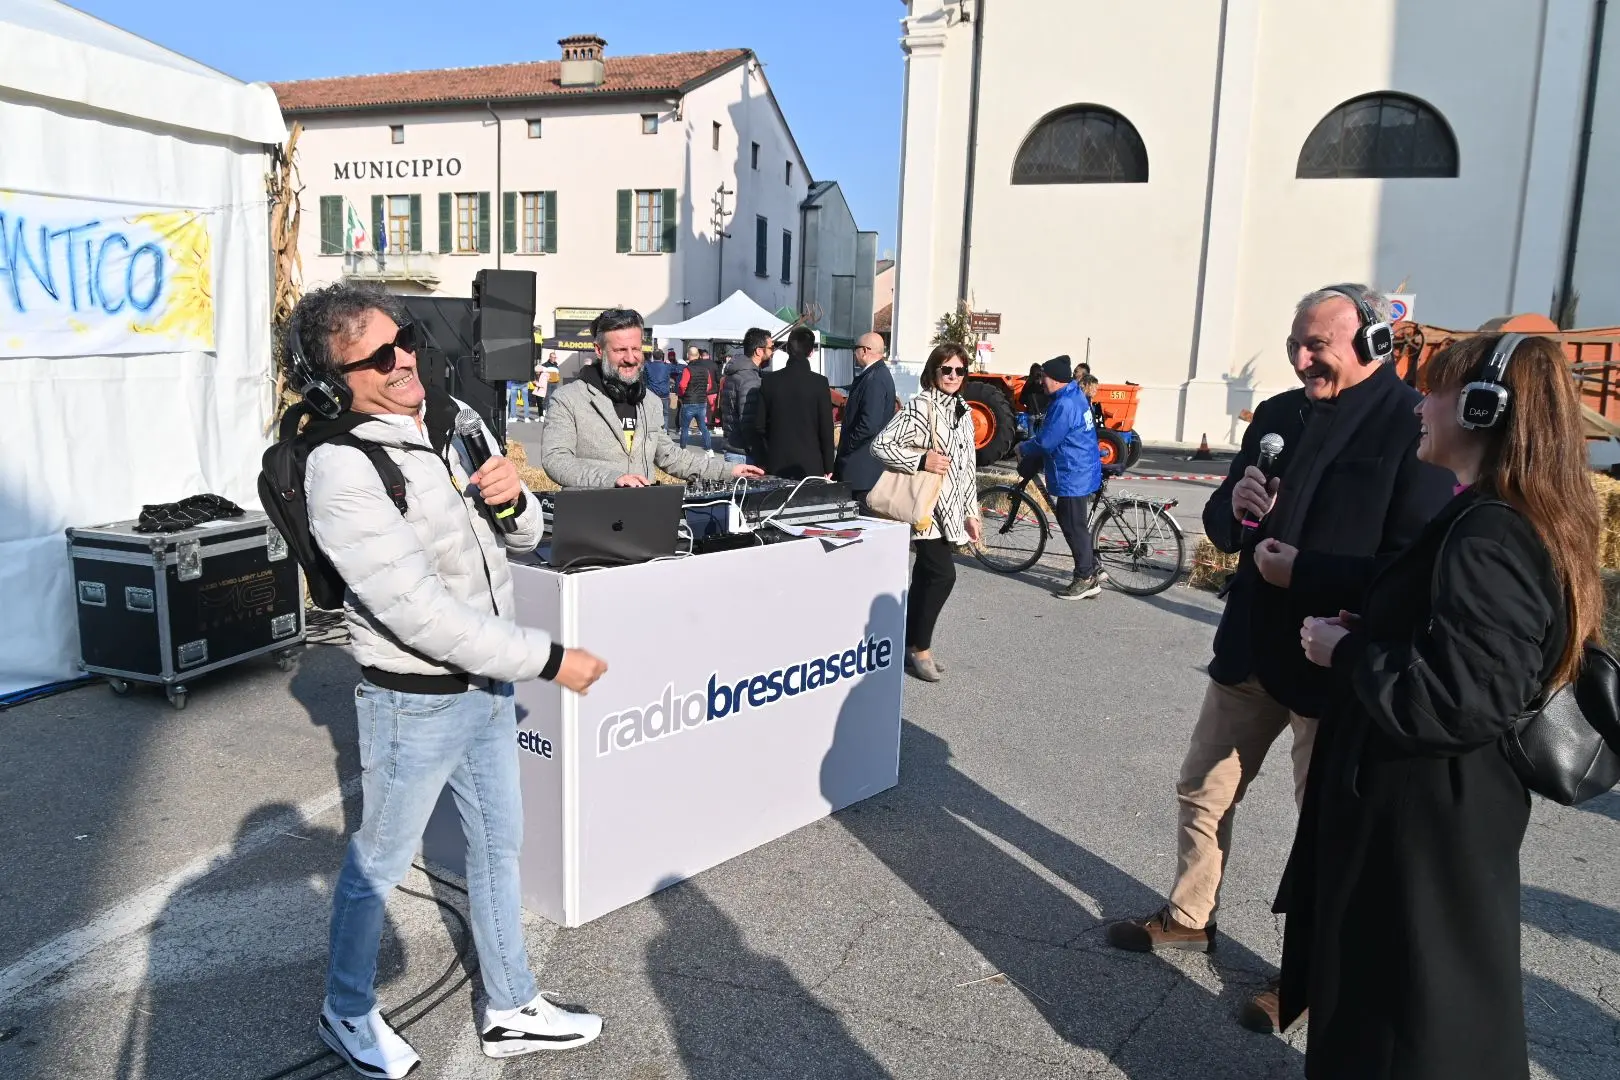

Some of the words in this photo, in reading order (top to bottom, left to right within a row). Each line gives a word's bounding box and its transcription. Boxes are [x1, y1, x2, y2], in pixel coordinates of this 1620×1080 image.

[333, 158, 462, 180] MUNICIPIO
[1377, 341, 1389, 351] DAP
[1111, 391, 1126, 400] 550
[1469, 407, 1489, 417] DAP
[597, 634, 893, 756] radiobresciasette
[516, 729, 552, 760] ette
